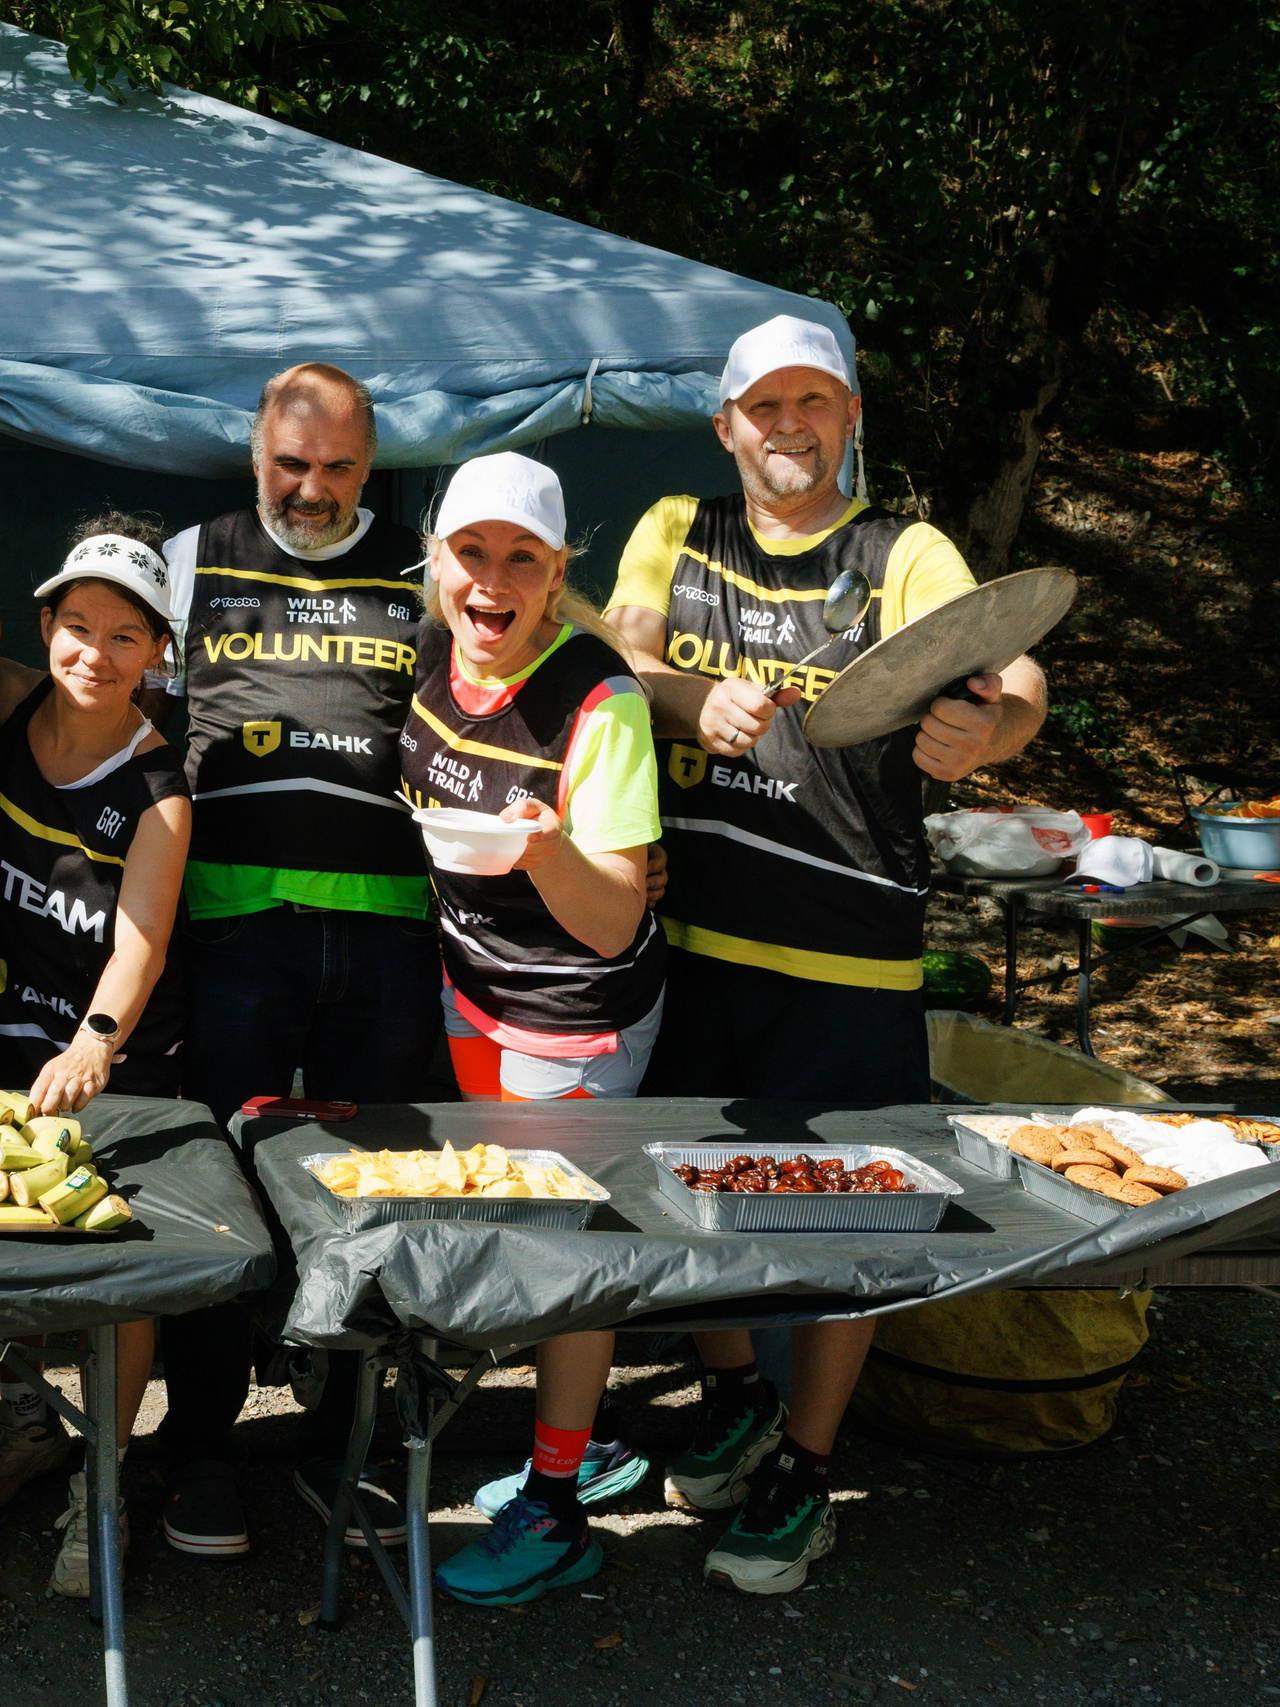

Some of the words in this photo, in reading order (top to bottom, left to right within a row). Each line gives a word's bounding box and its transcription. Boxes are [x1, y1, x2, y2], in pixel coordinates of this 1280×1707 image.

[286, 611, 340, 625] TRAIL
[287, 597, 335, 611] WILD
[203, 632, 417, 676] VOLUNTEER
[289, 731, 373, 755] БАНК
[431, 752, 470, 780] WILD
[427, 767, 466, 799] TRAIL
[711, 765, 799, 803] БАНК
[0, 859, 106, 944] TEAM
[14, 984, 78, 1020] АНК
